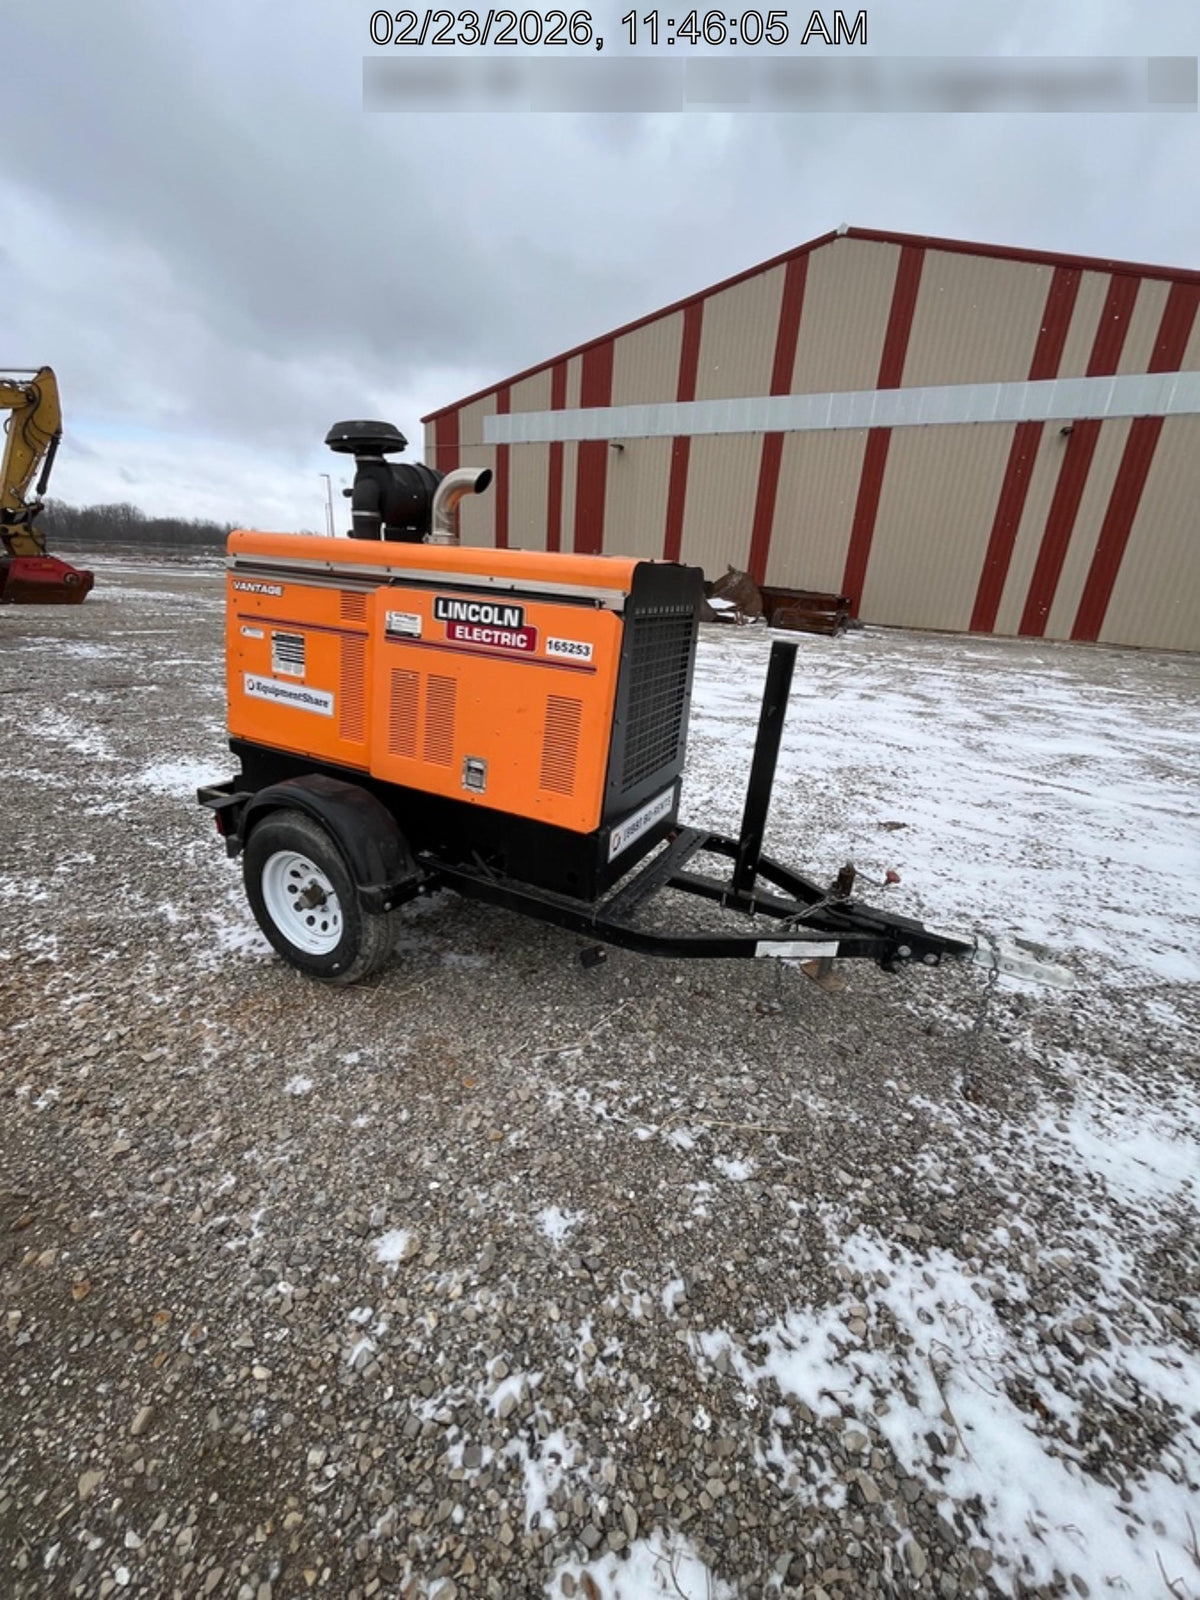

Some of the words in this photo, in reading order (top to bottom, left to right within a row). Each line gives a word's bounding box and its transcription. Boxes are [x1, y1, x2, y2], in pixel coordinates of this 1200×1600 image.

[233, 581, 283, 596] VANTAGE
[437, 600, 520, 627] LINCOLN
[455, 625, 527, 648] ELECTRIC
[547, 639, 591, 657] 165253
[256, 681, 329, 708] EquipmentShare
